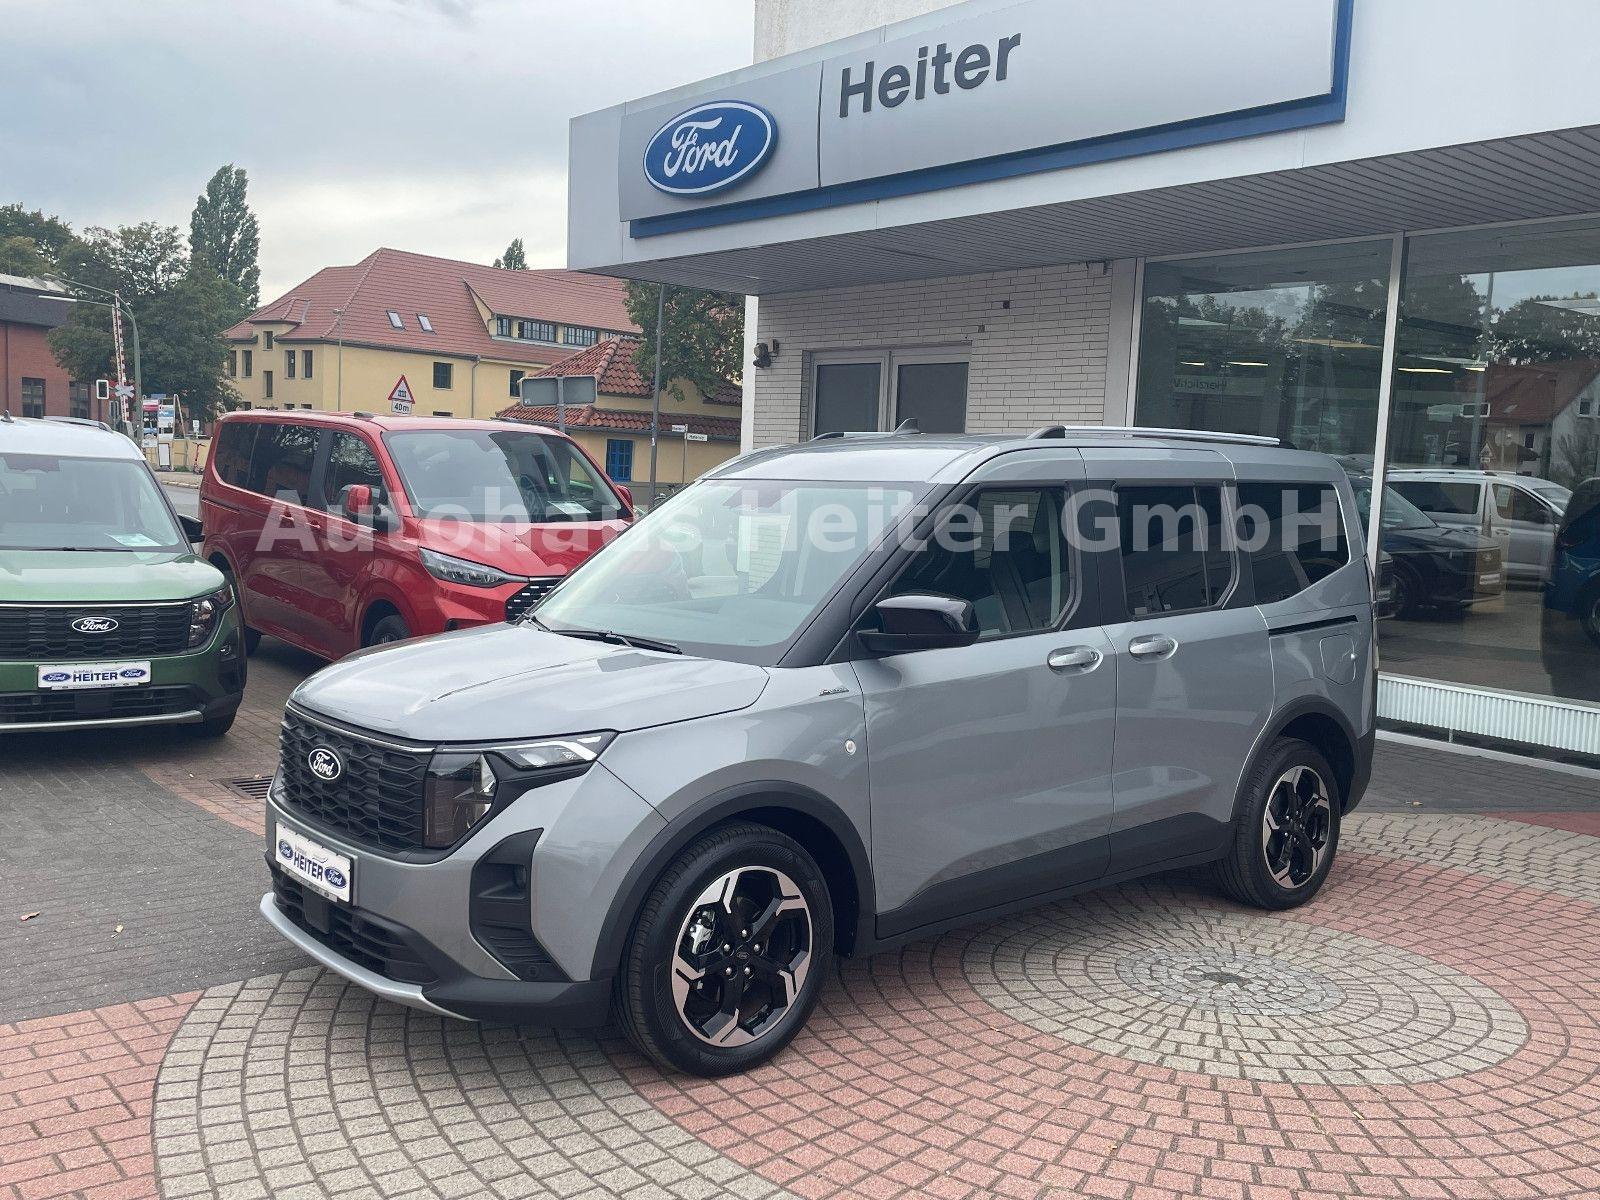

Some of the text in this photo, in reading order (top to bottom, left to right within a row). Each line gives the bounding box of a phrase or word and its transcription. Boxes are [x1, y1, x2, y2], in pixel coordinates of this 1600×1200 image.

[839, 33, 1022, 119] Heiter
[664, 116, 743, 178] Ford
[80, 618, 110, 631] Ford
[73, 672, 118, 683] HEITER
[313, 751, 334, 777] Ford
[293, 851, 324, 881] HEITER
